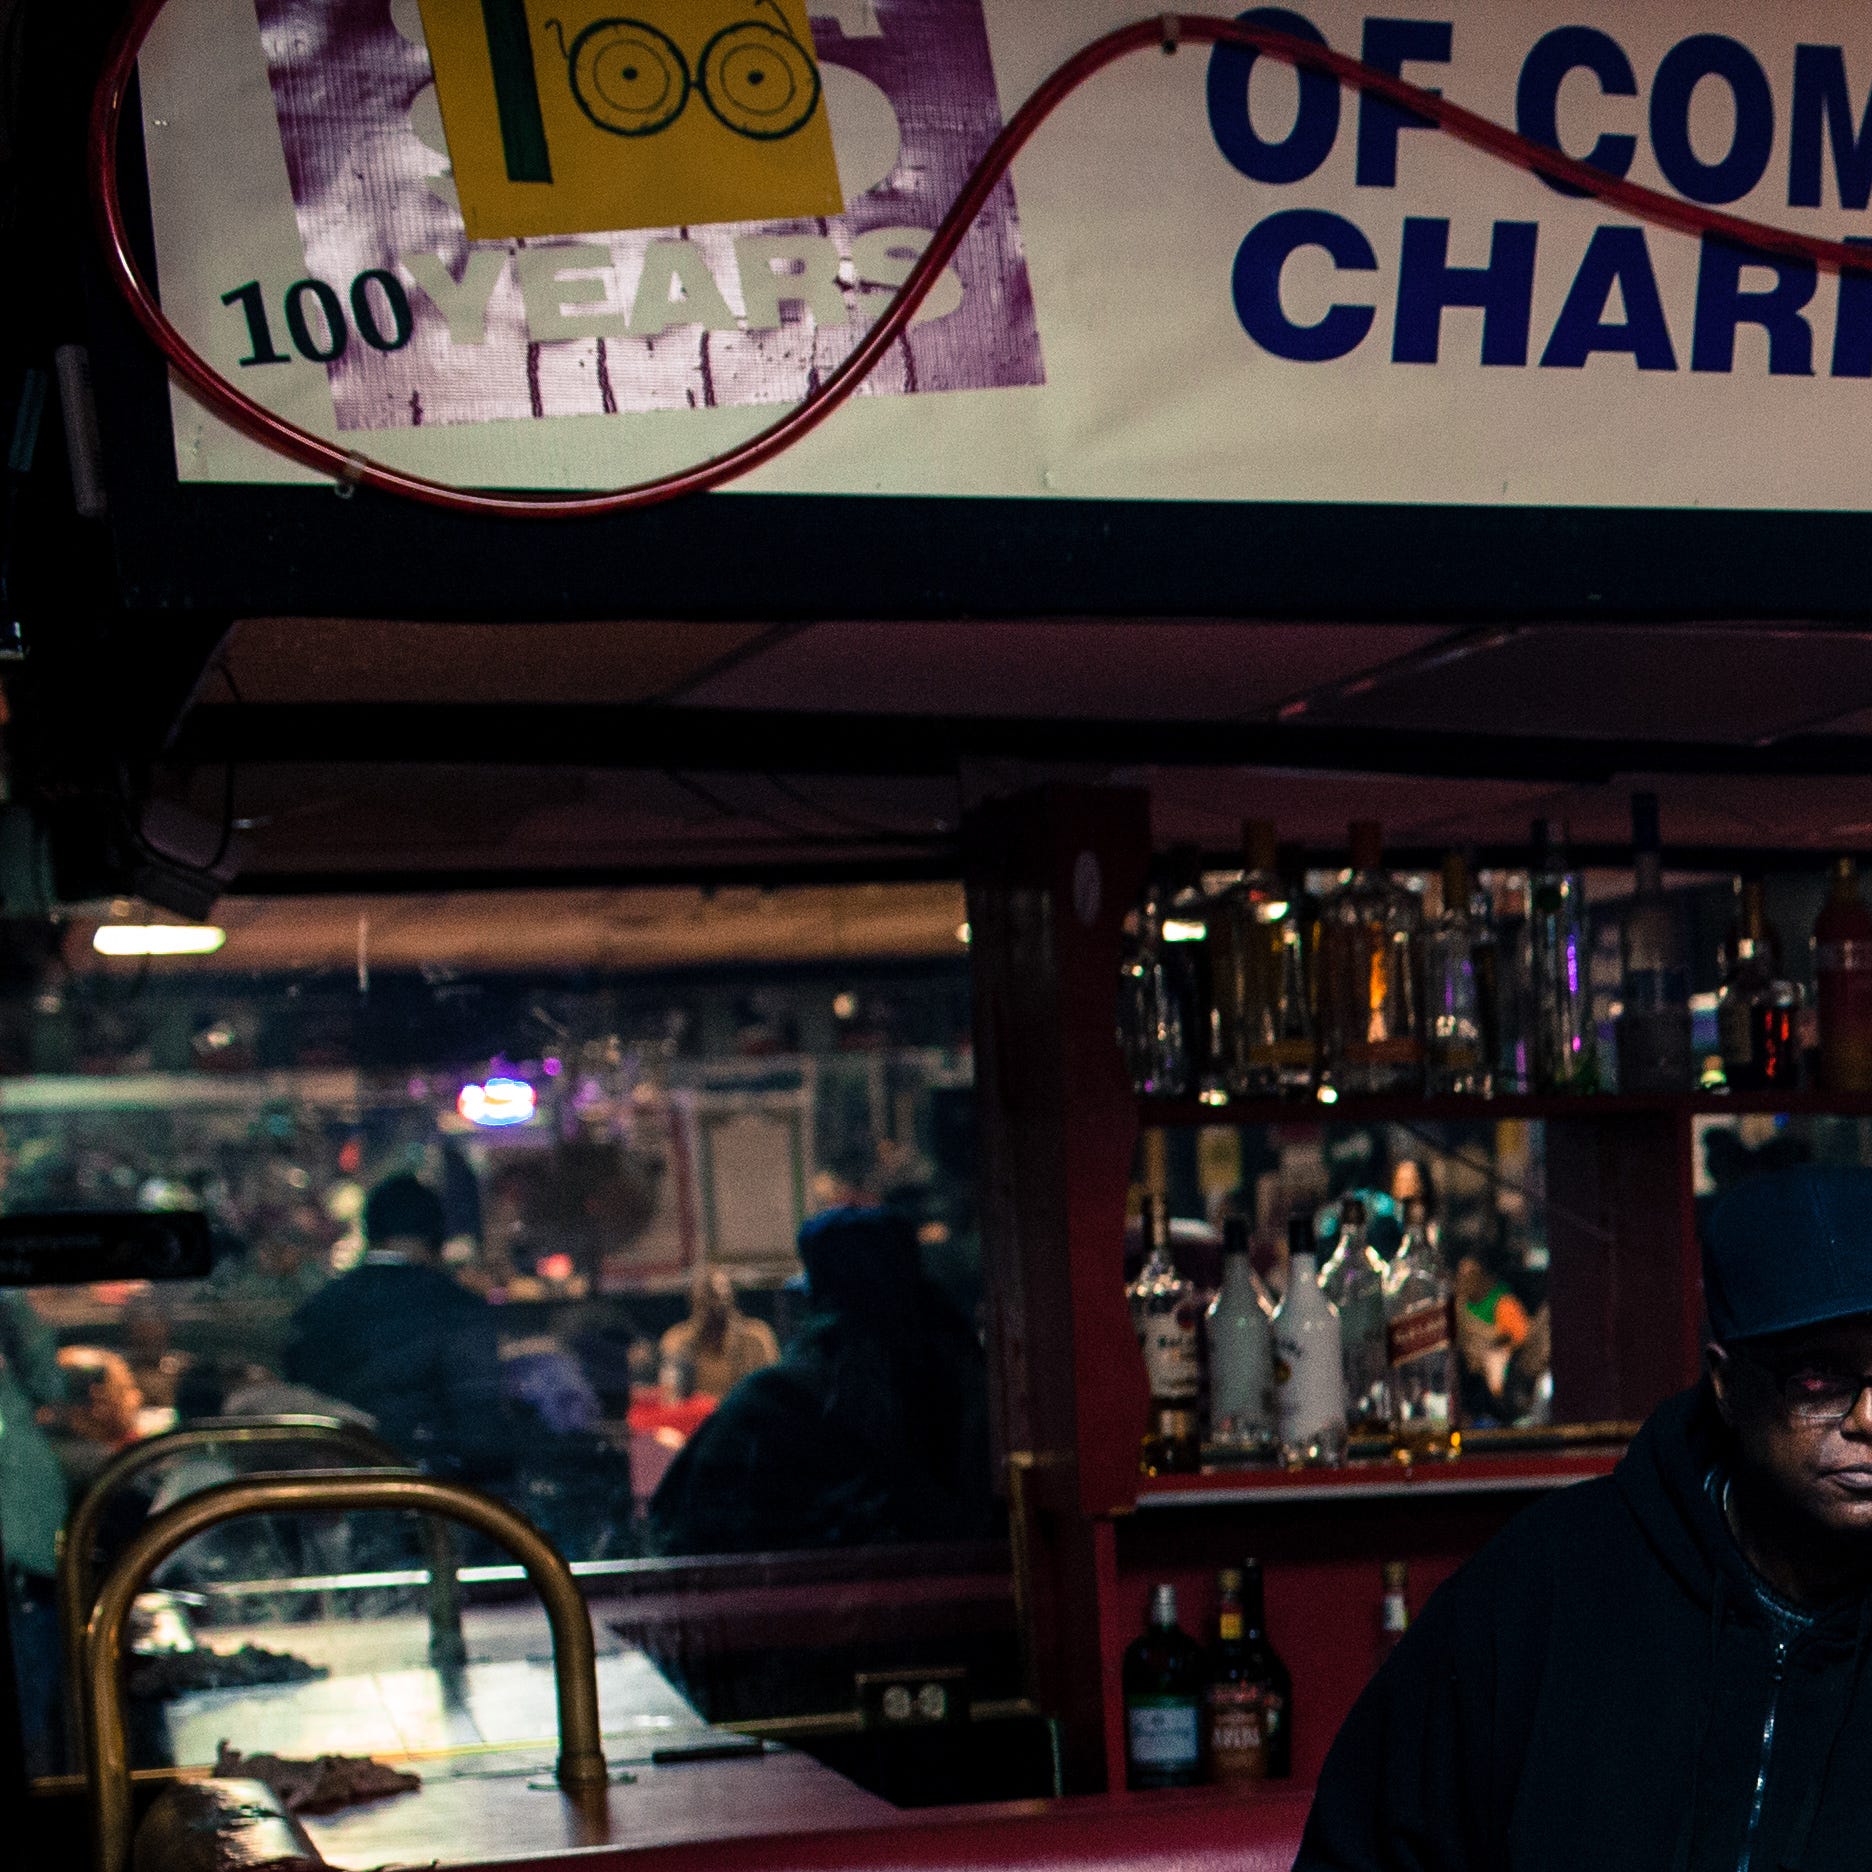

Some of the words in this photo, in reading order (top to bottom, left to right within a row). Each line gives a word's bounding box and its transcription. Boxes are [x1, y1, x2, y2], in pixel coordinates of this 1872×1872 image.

[1206, 7, 1453, 188] OF
[221, 268, 415, 367] 100
[402, 226, 965, 345] YEARS
